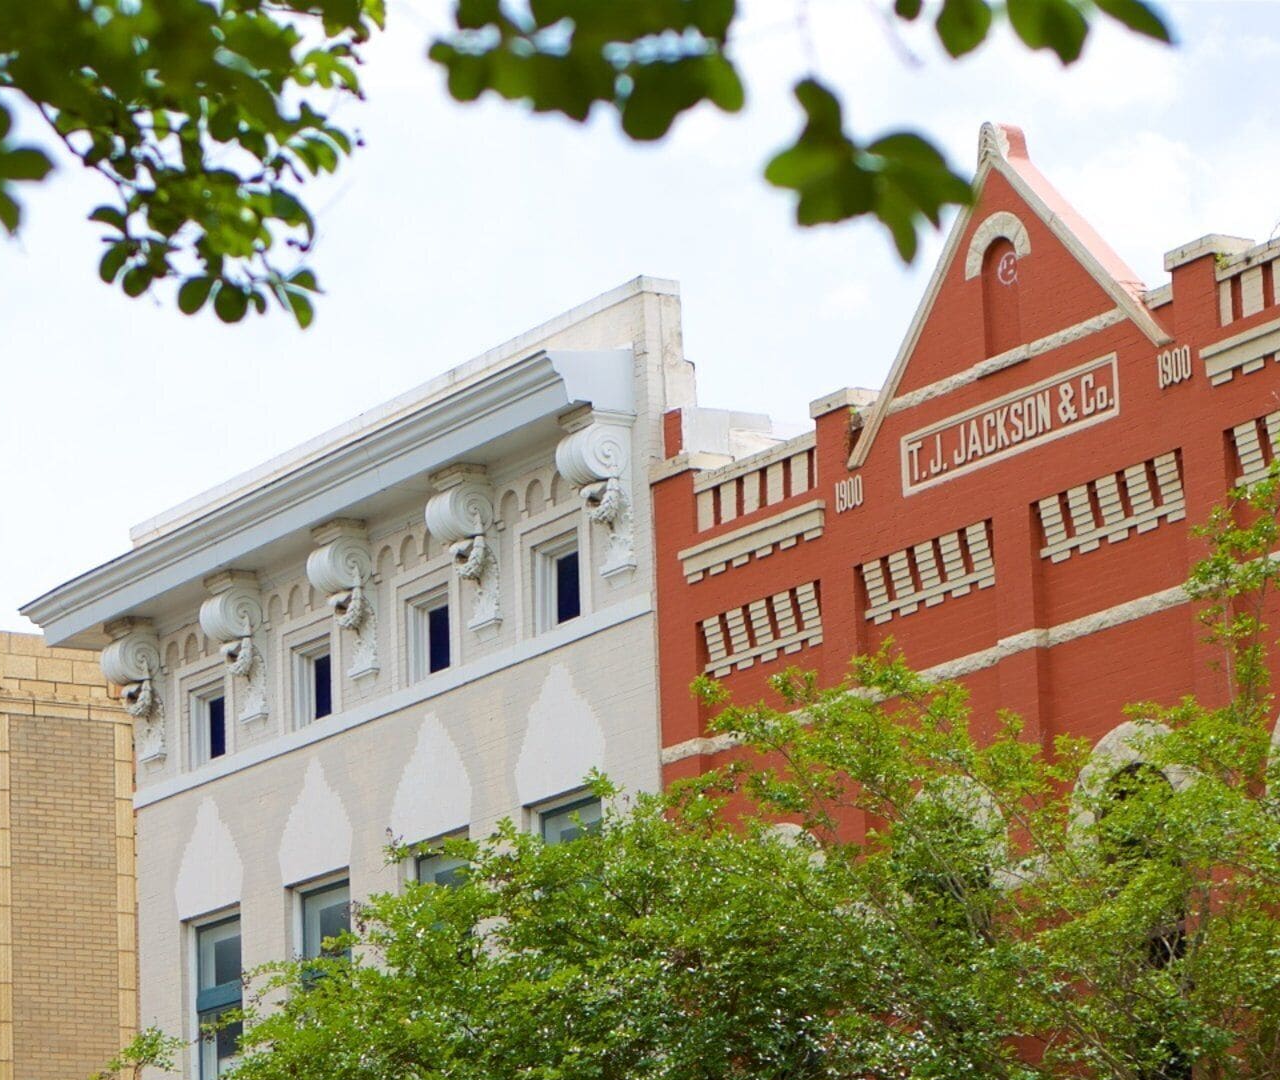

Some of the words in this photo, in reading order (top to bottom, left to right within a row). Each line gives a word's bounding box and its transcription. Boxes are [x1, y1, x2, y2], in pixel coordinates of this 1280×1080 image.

[1157, 344, 1191, 389] 1900
[908, 440, 927, 481] T.
[930, 433, 948, 474] J.
[954, 390, 1051, 465] JACKSON
[1058, 381, 1078, 423] &
[1081, 373, 1115, 416] Co.
[835, 474, 863, 513] 1900
